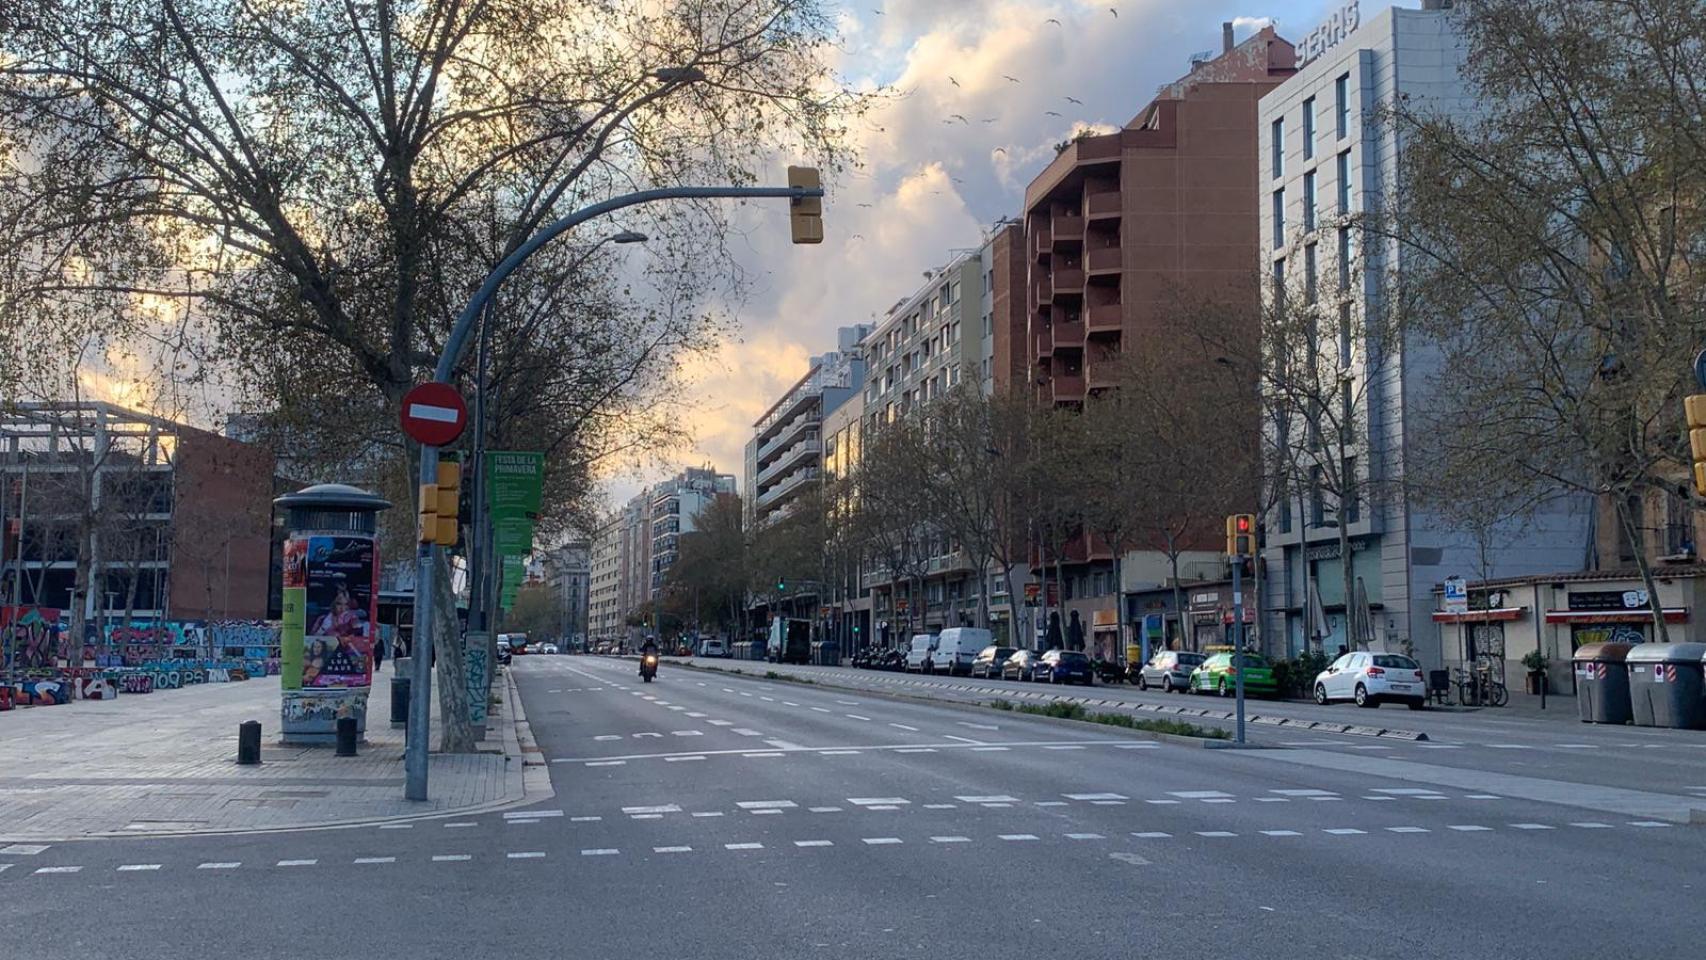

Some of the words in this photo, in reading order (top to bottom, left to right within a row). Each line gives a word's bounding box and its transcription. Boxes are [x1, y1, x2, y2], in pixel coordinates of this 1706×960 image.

[1295, 0, 1361, 70] SERHS
[495, 455, 516, 464] FESTA
[517, 455, 527, 464] DE
[528, 455, 536, 464] LA
[495, 464, 537, 474] PRIMAVERA
